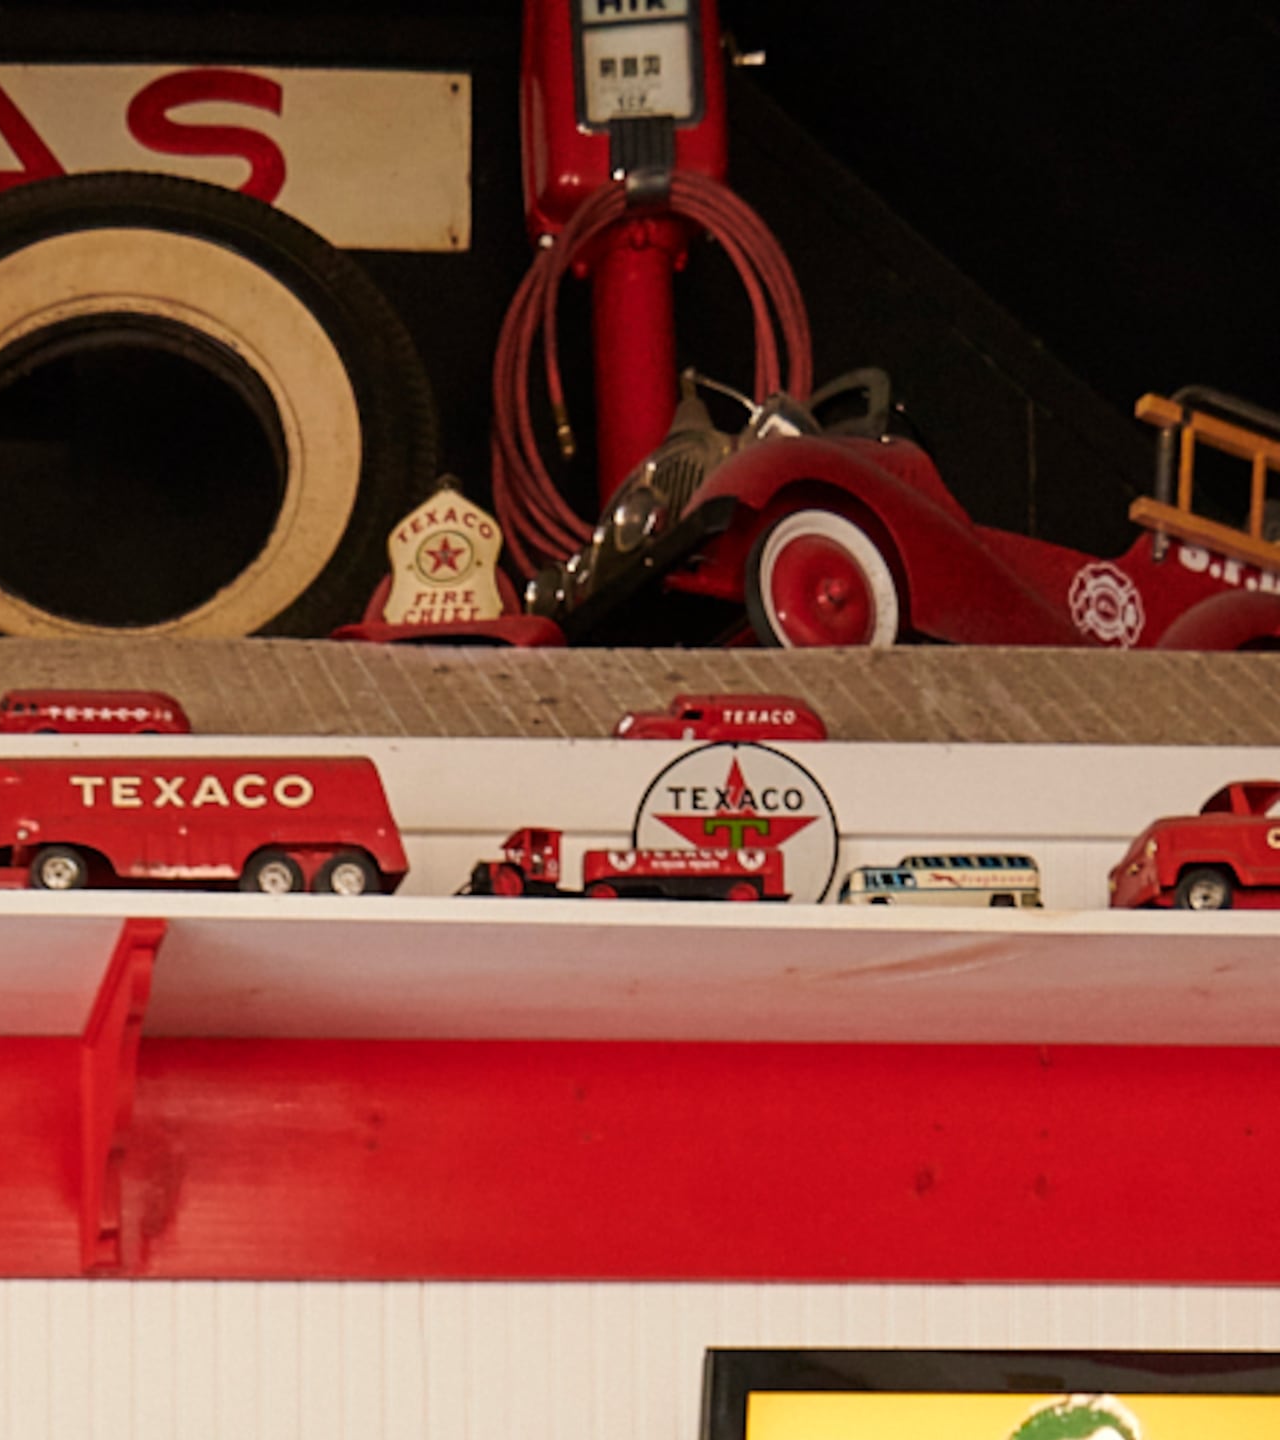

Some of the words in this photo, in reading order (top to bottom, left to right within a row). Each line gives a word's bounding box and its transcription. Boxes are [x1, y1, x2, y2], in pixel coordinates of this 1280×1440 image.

[396, 506, 494, 544] TEXACO
[413, 590, 475, 607] FIRE
[722, 709, 797, 726] TEXACO
[69, 774, 316, 809] TEXACO
[667, 786, 804, 812] TEXACO
